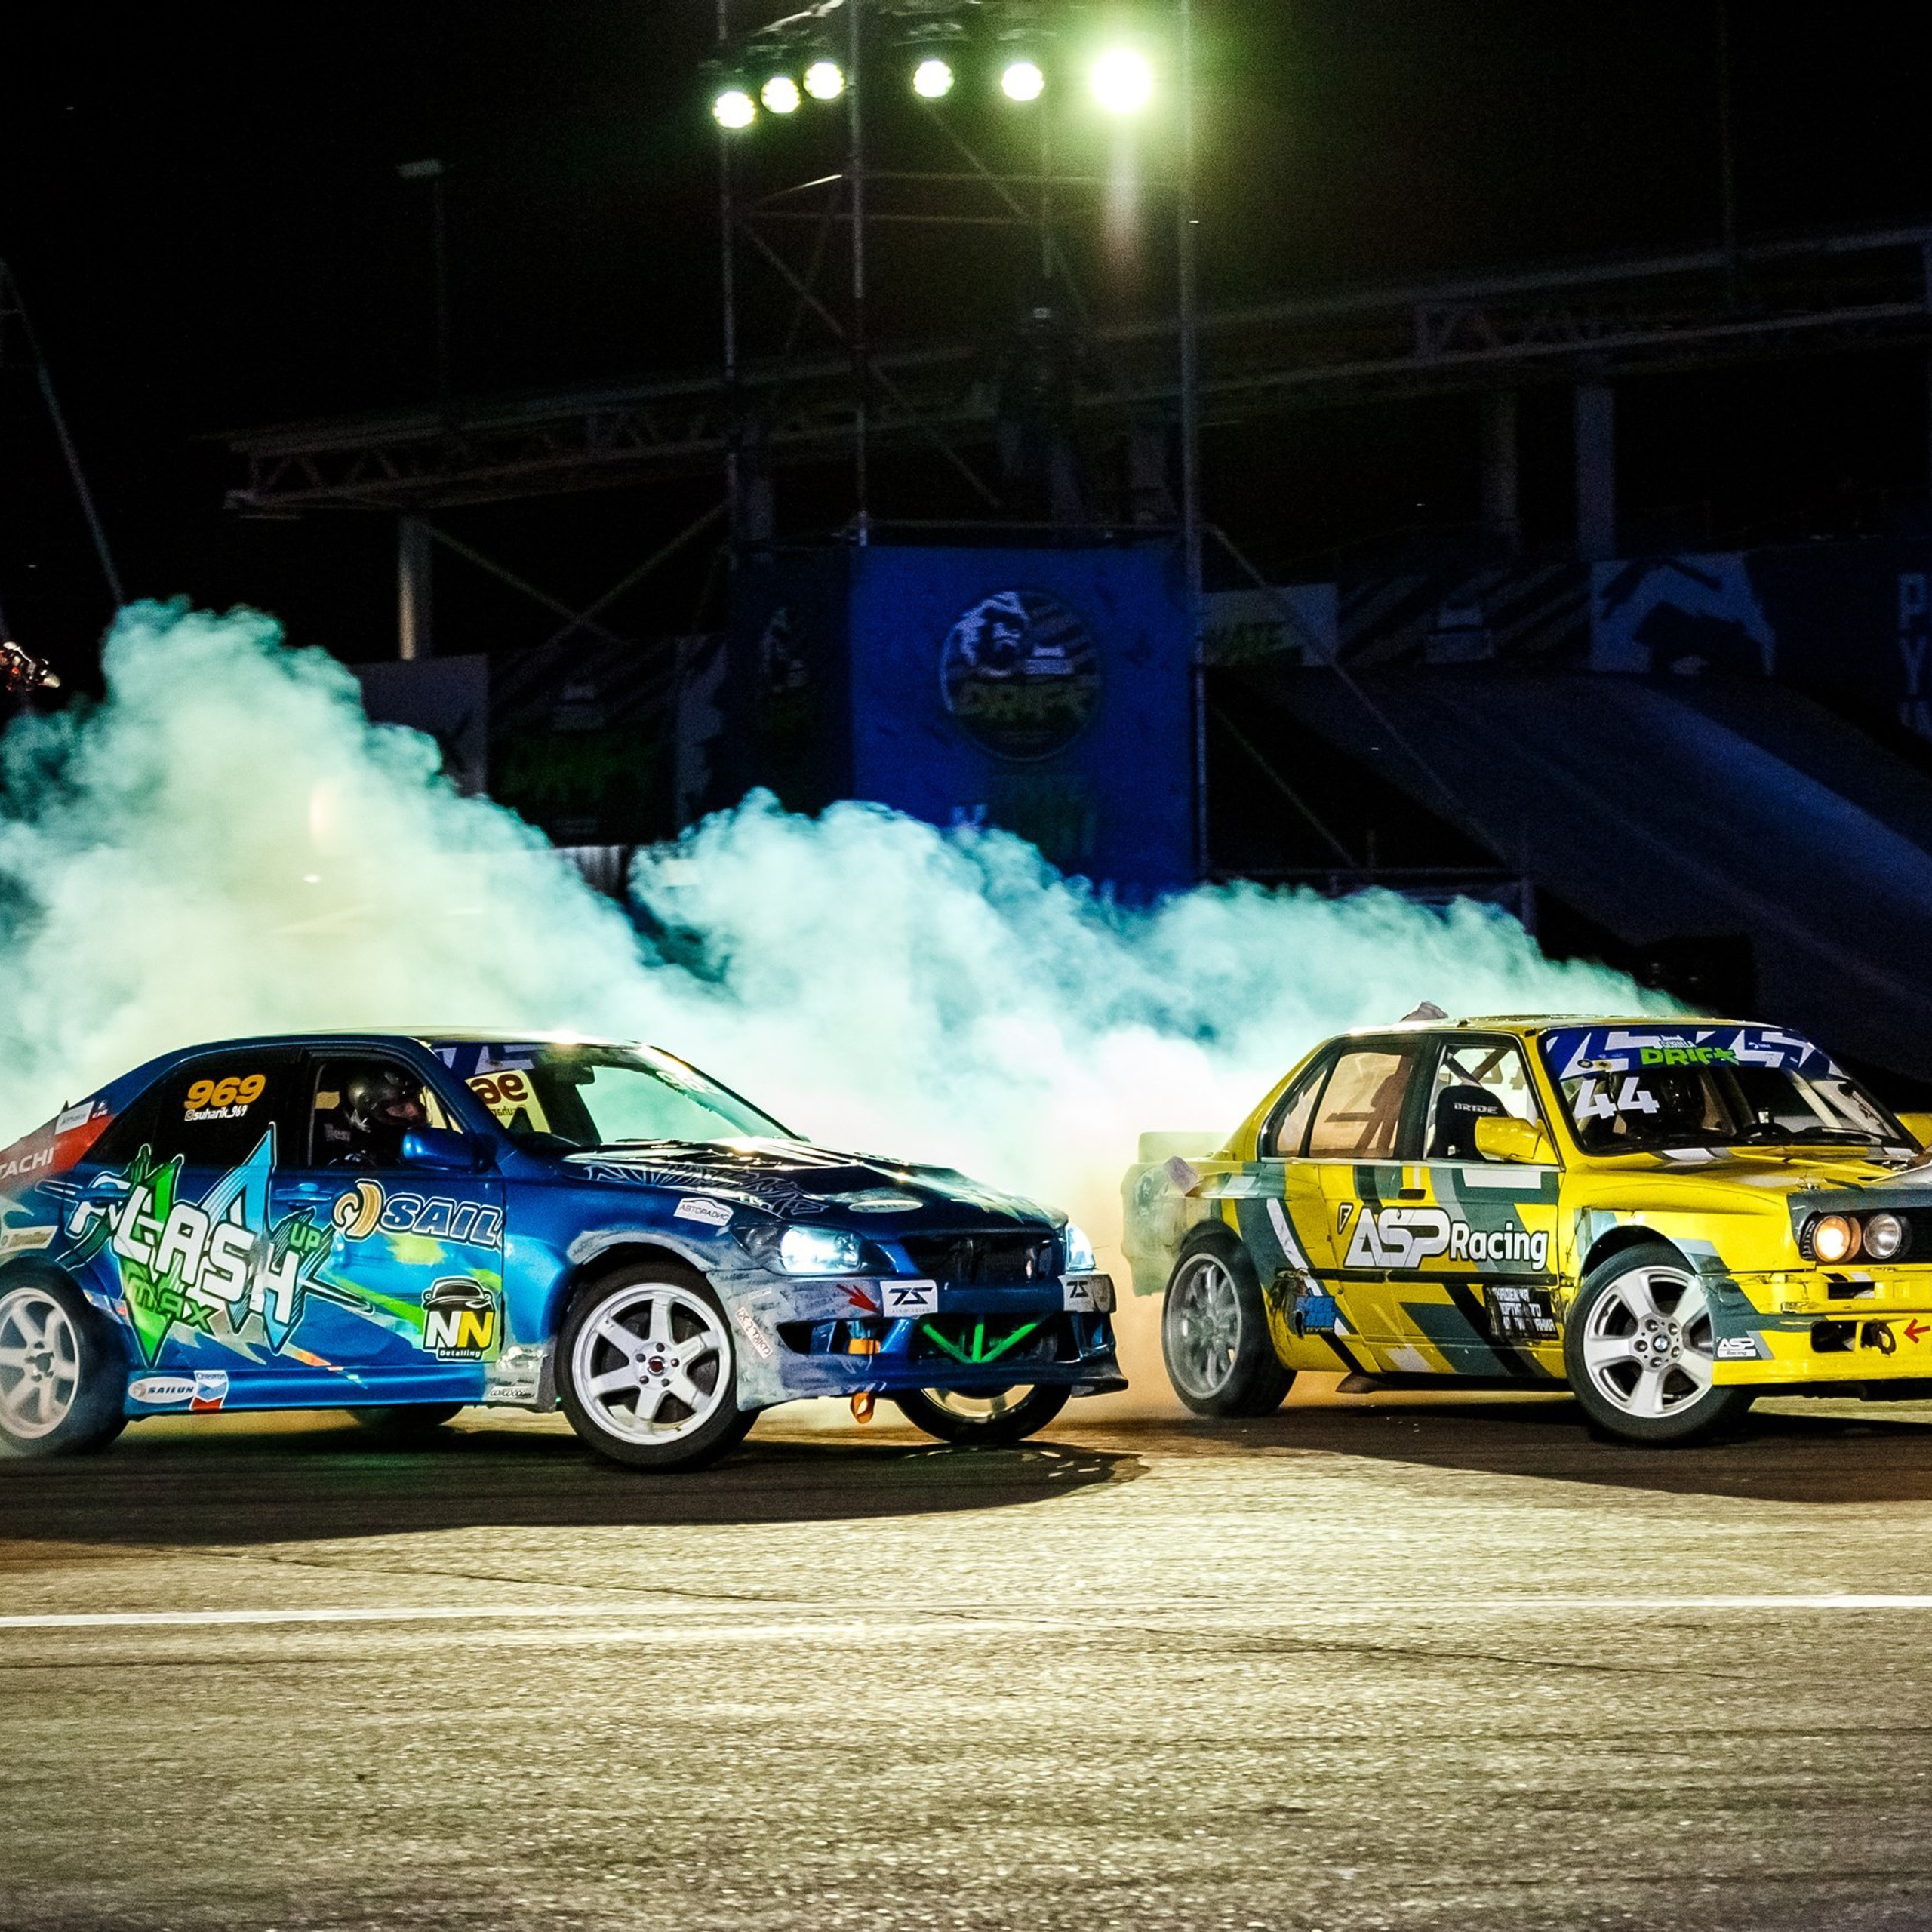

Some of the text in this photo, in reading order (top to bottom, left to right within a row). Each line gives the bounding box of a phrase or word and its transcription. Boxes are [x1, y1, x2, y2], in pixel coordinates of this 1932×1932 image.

[184, 1074, 266, 1109] 969
[1453, 1102, 1498, 1115] BRIDE
[1573, 1077, 1660, 1119] 44
[290, 1223, 322, 1250] UP
[380, 1197, 502, 1246] SAIL
[1344, 1208, 1548, 1269] ASP Racing
[424, 1310, 494, 1348] NN
[1718, 1337, 1755, 1349] ASP
[439, 1349, 481, 1358] Detailing
